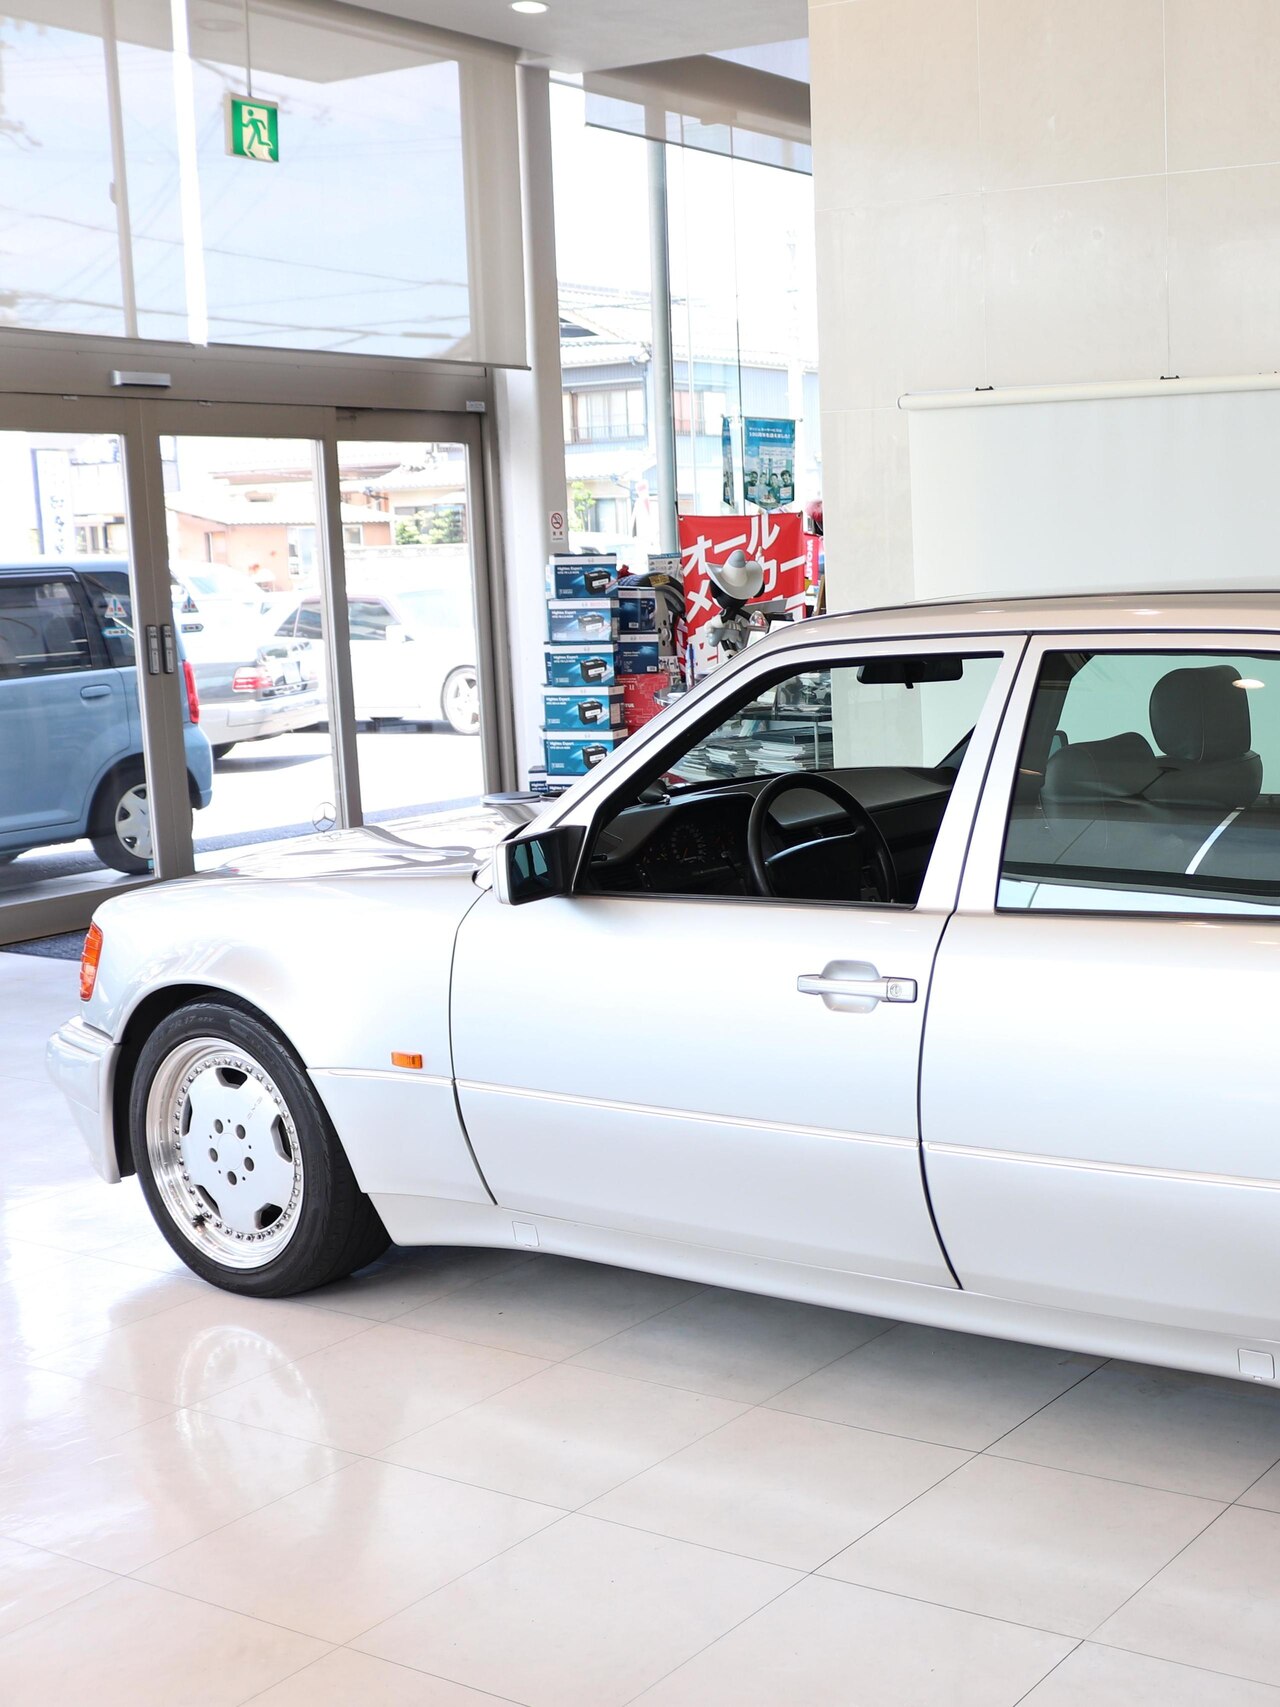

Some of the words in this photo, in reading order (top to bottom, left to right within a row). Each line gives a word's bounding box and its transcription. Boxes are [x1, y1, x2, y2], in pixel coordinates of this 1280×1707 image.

[681, 514, 781, 577] オール
[687, 555, 806, 623] メカー
